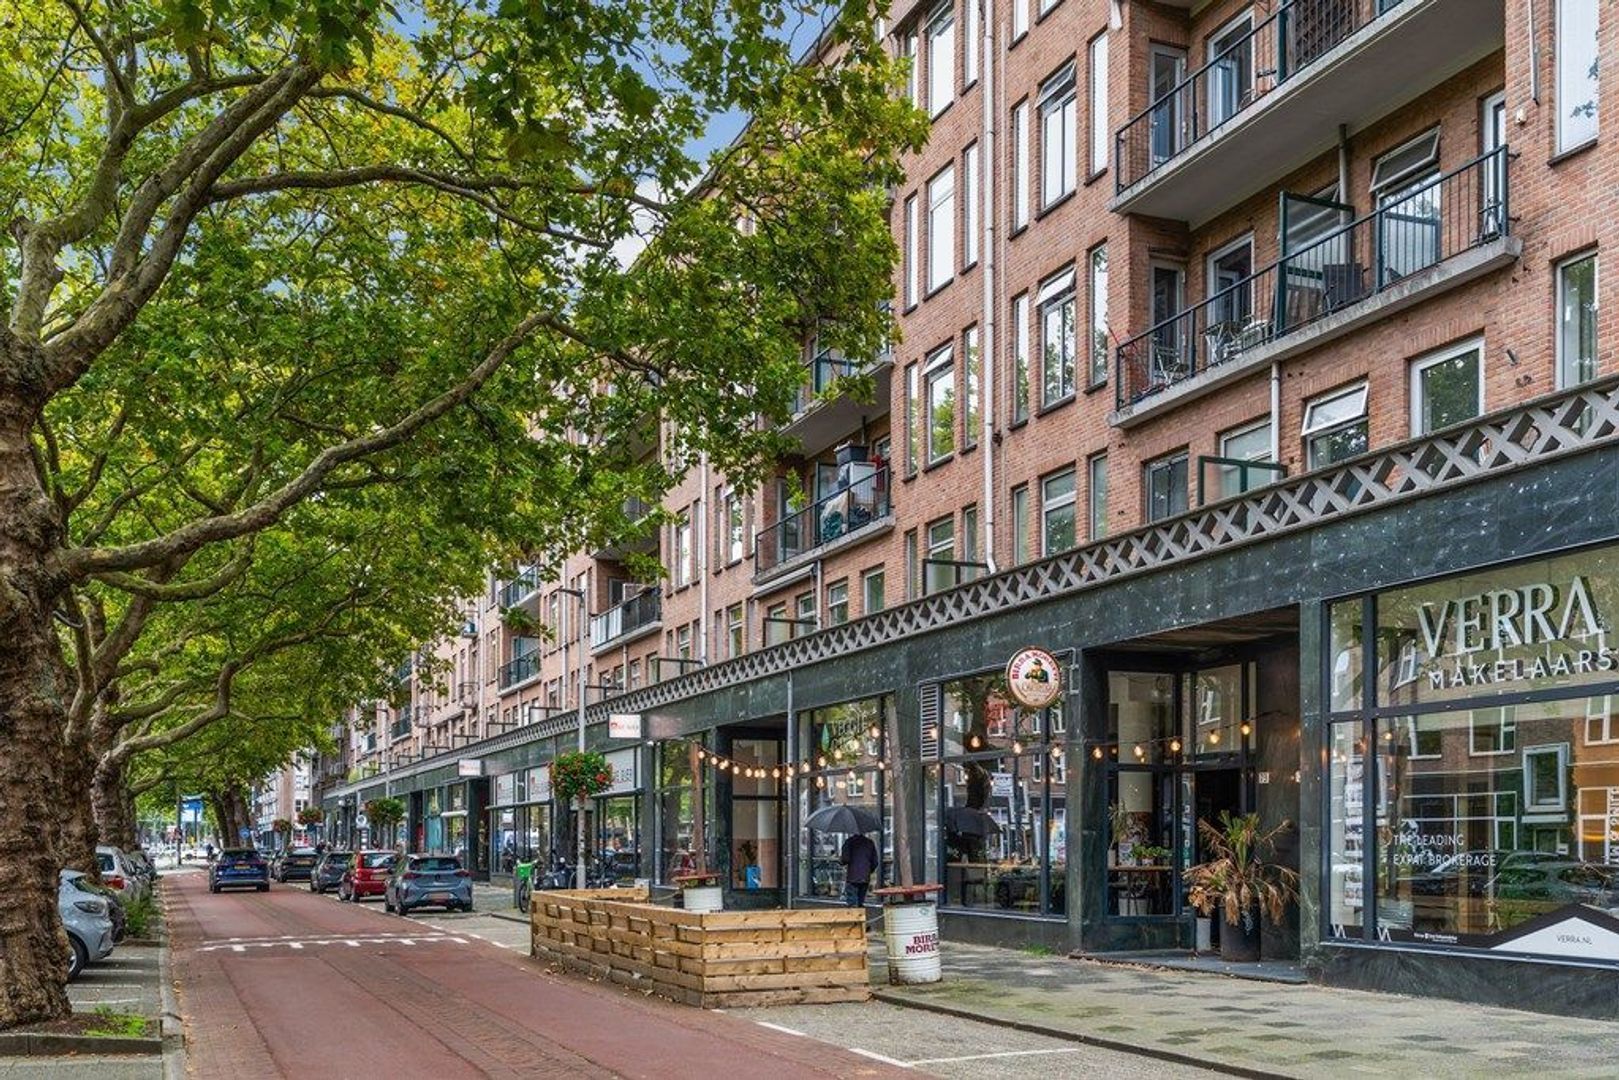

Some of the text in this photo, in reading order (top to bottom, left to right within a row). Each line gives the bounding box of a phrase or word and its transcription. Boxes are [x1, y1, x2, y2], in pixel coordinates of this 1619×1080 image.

[1416, 575, 1604, 657] VERRA
[1429, 647, 1612, 690] MAKELAARS
[1393, 834, 1464, 846] THE LEADING
[1393, 853, 1497, 866] EXPAT BROKERAGE
